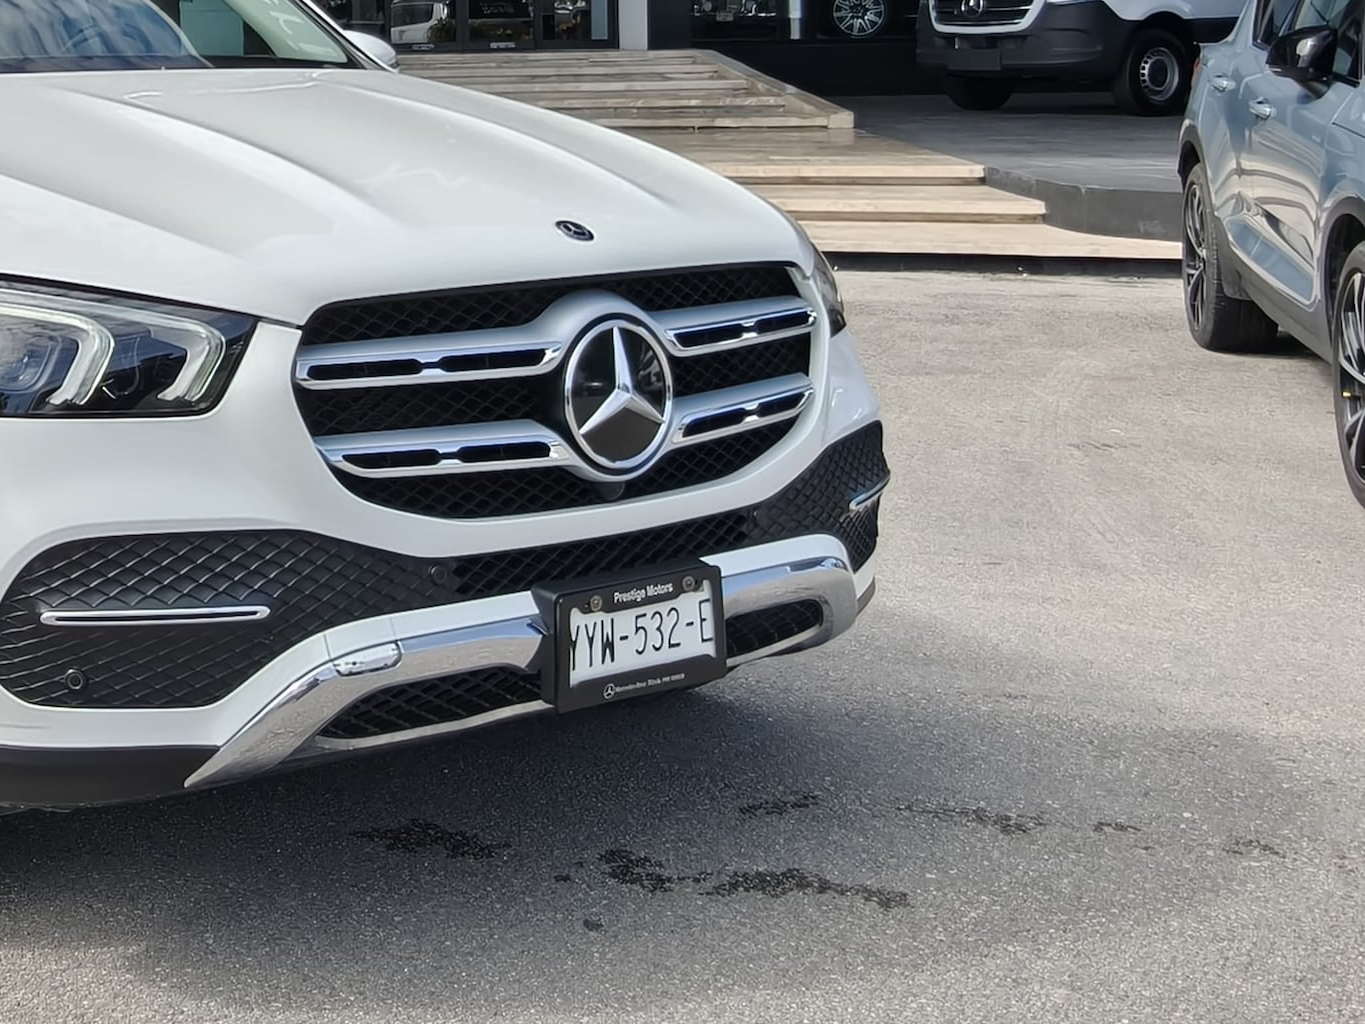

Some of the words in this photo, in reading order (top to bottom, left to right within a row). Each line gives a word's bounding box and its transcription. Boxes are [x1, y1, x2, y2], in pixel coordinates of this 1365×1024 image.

[613, 588, 646, 604] Prestige
[646, 583, 674, 596] Motors
[569, 598, 714, 672] YYW-532-E
